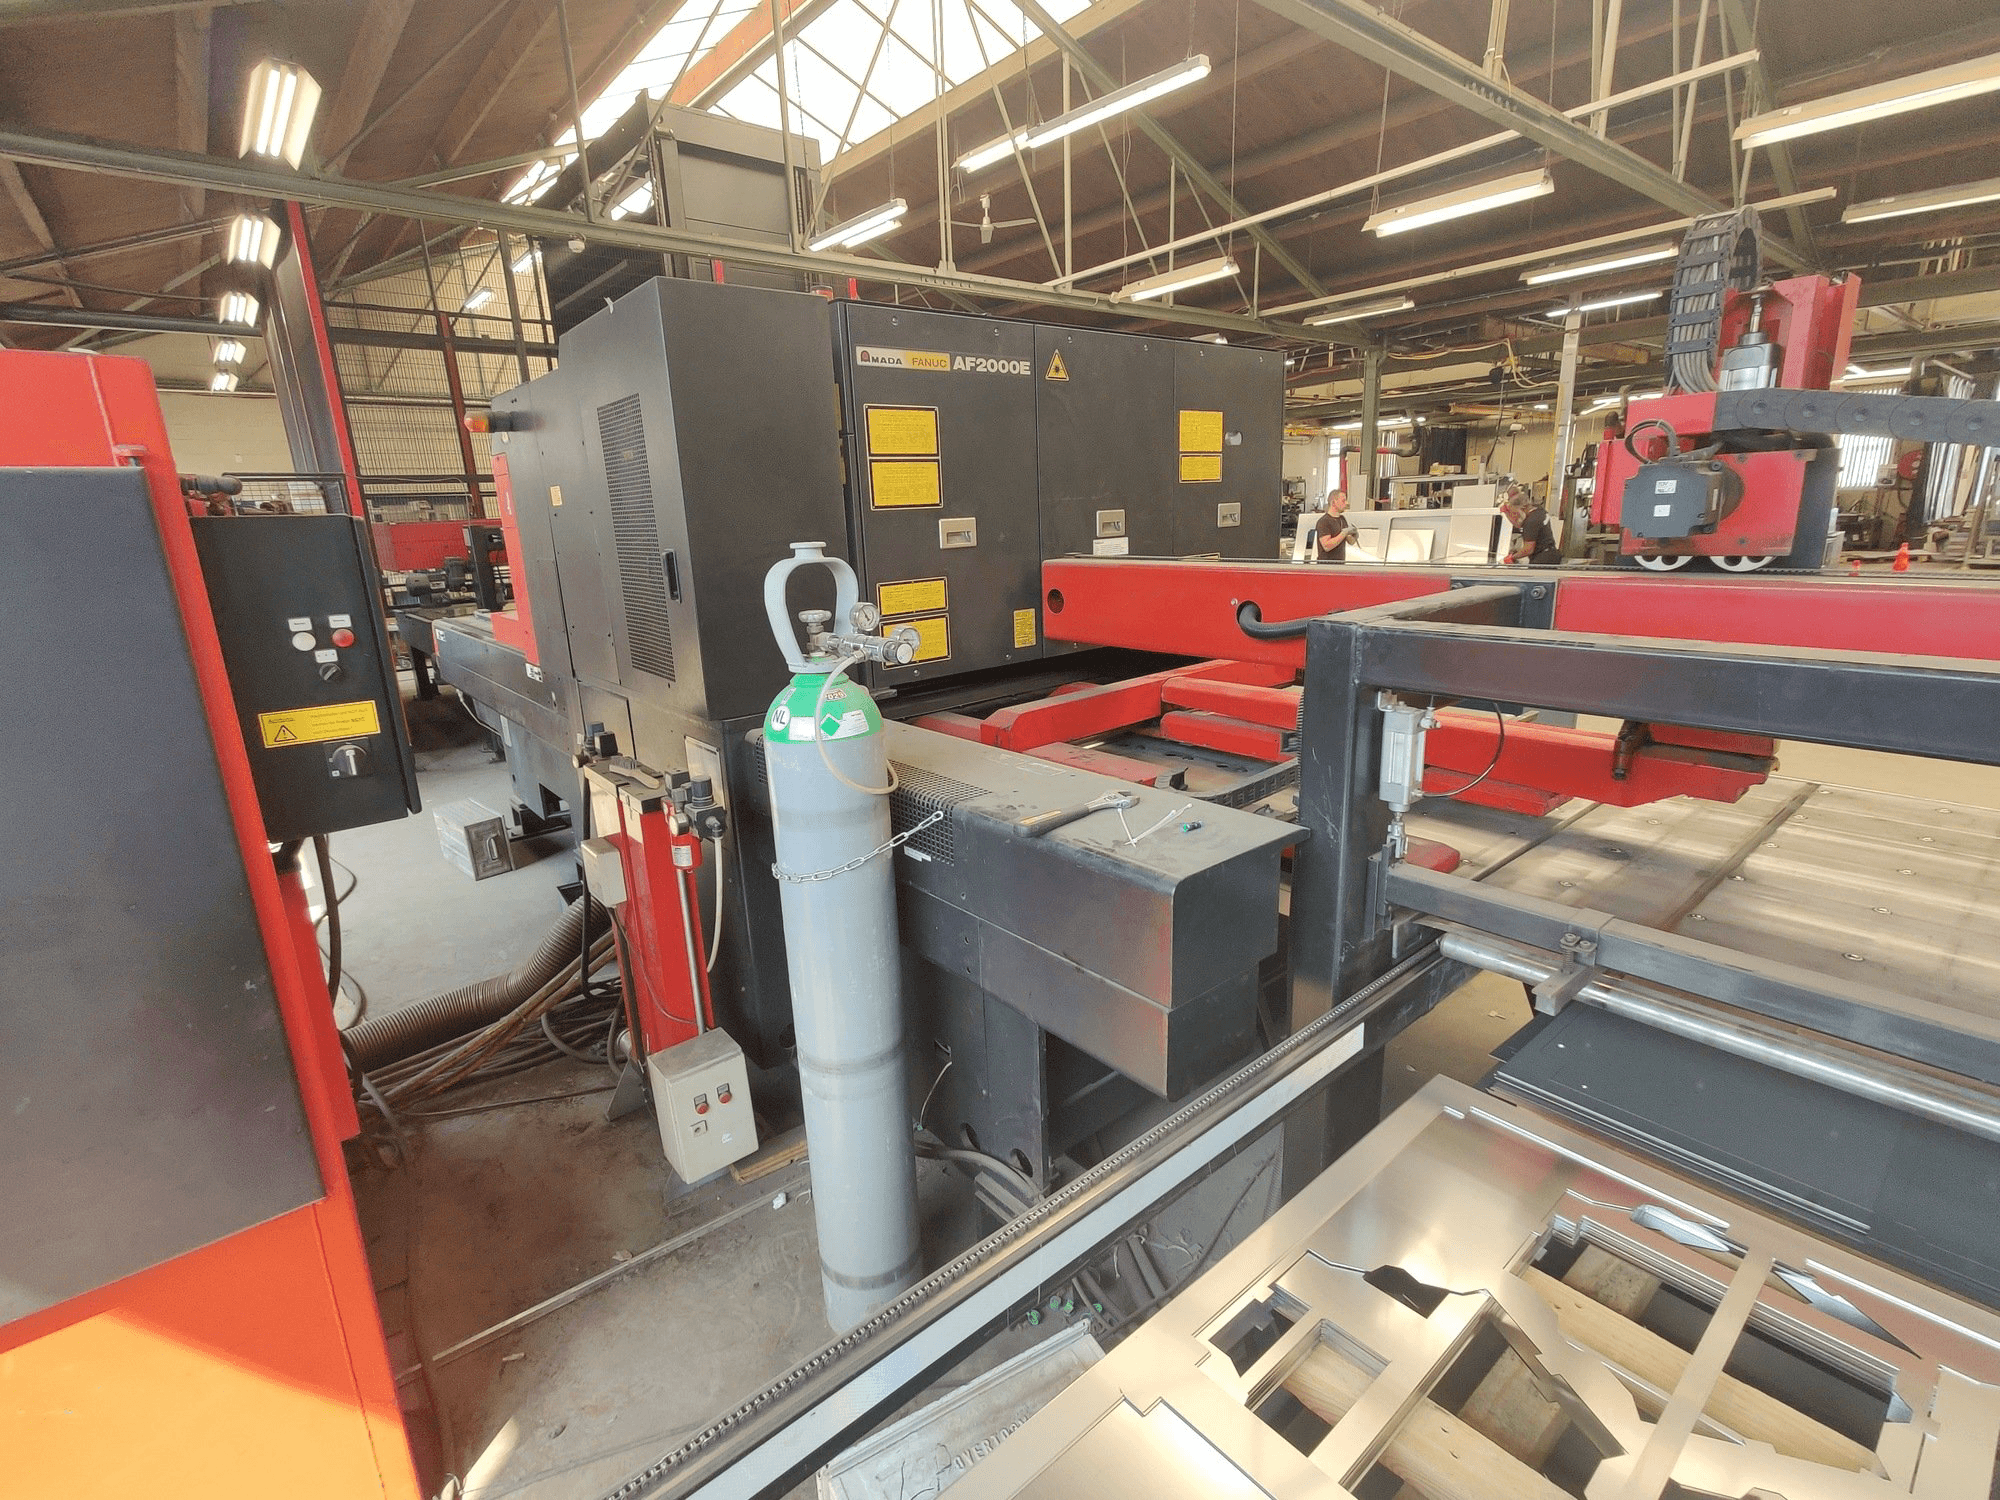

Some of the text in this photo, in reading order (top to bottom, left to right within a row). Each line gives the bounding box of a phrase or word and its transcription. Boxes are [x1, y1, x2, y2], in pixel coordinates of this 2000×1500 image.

[860, 350, 1031, 375] AMADA FANUC AF2000E
[772, 709, 786, 725] NL
